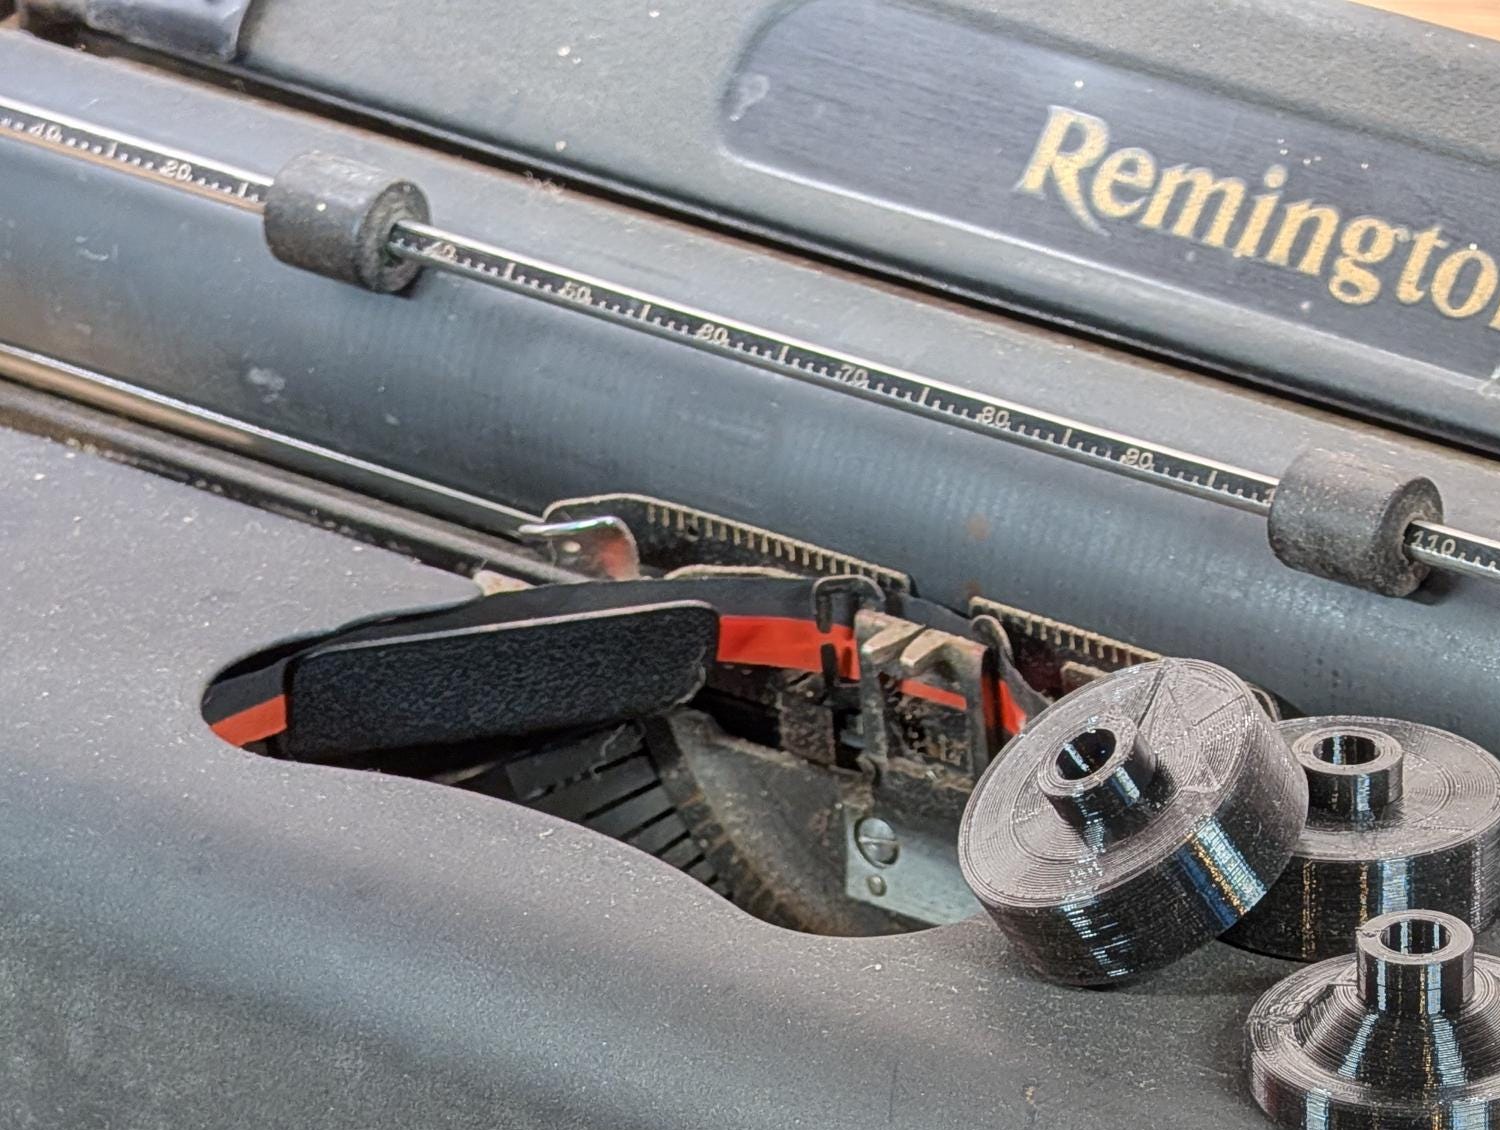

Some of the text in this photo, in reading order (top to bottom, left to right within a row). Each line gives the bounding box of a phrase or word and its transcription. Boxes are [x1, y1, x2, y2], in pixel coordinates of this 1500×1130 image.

[160, 160, 190, 180] 20
[841, 364, 869, 384] 70
[980, 406, 1010, 427] 80
[1410, 531, 1456, 556] 110
